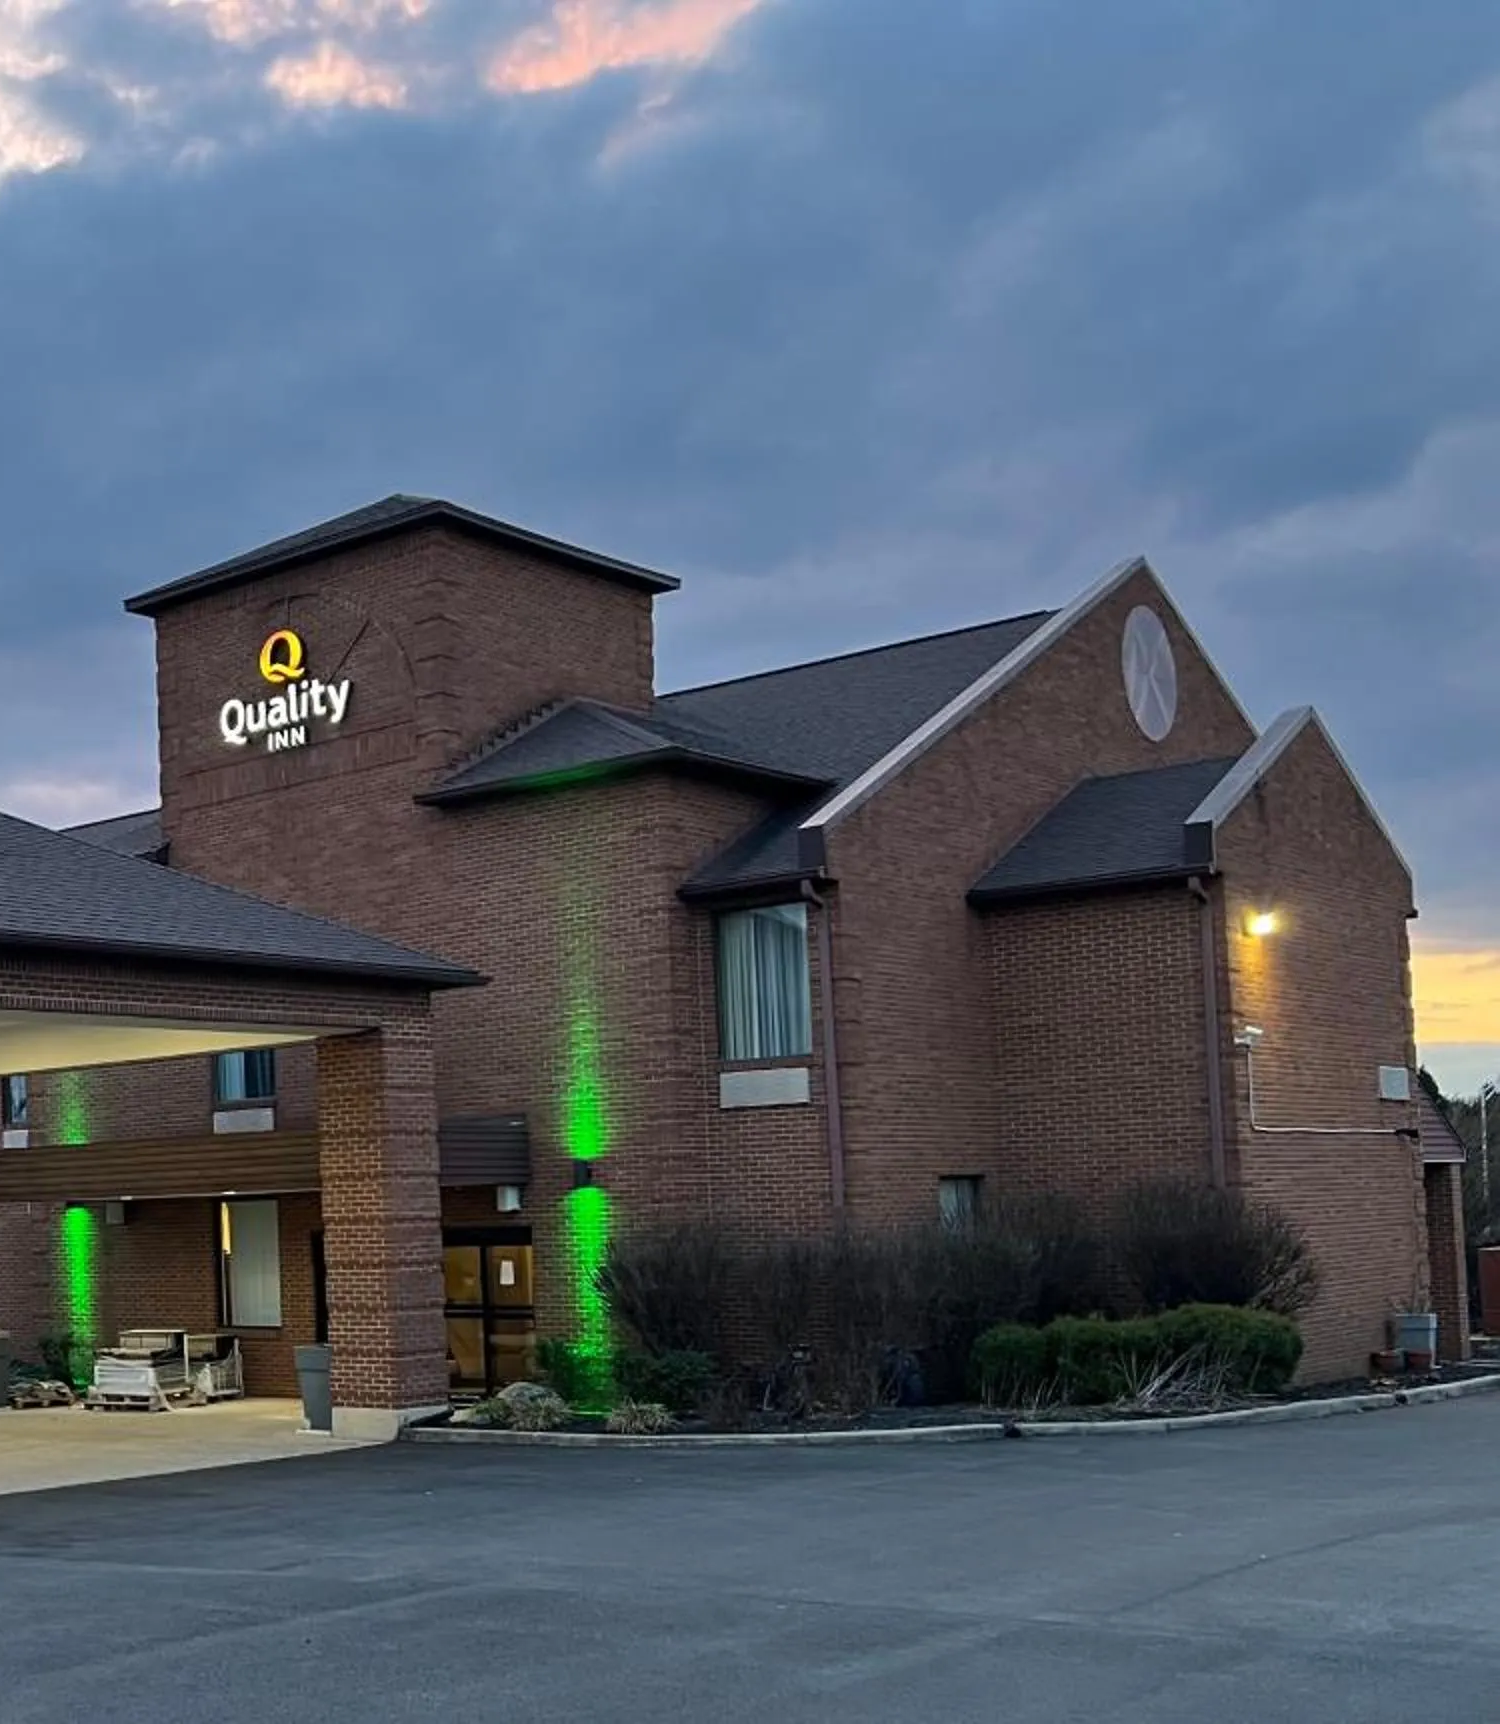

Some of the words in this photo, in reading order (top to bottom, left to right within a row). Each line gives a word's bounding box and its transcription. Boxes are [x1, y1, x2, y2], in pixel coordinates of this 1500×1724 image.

[259, 629, 305, 683] Q
[220, 679, 350, 745] Quality
[267, 725, 305, 752] INN
